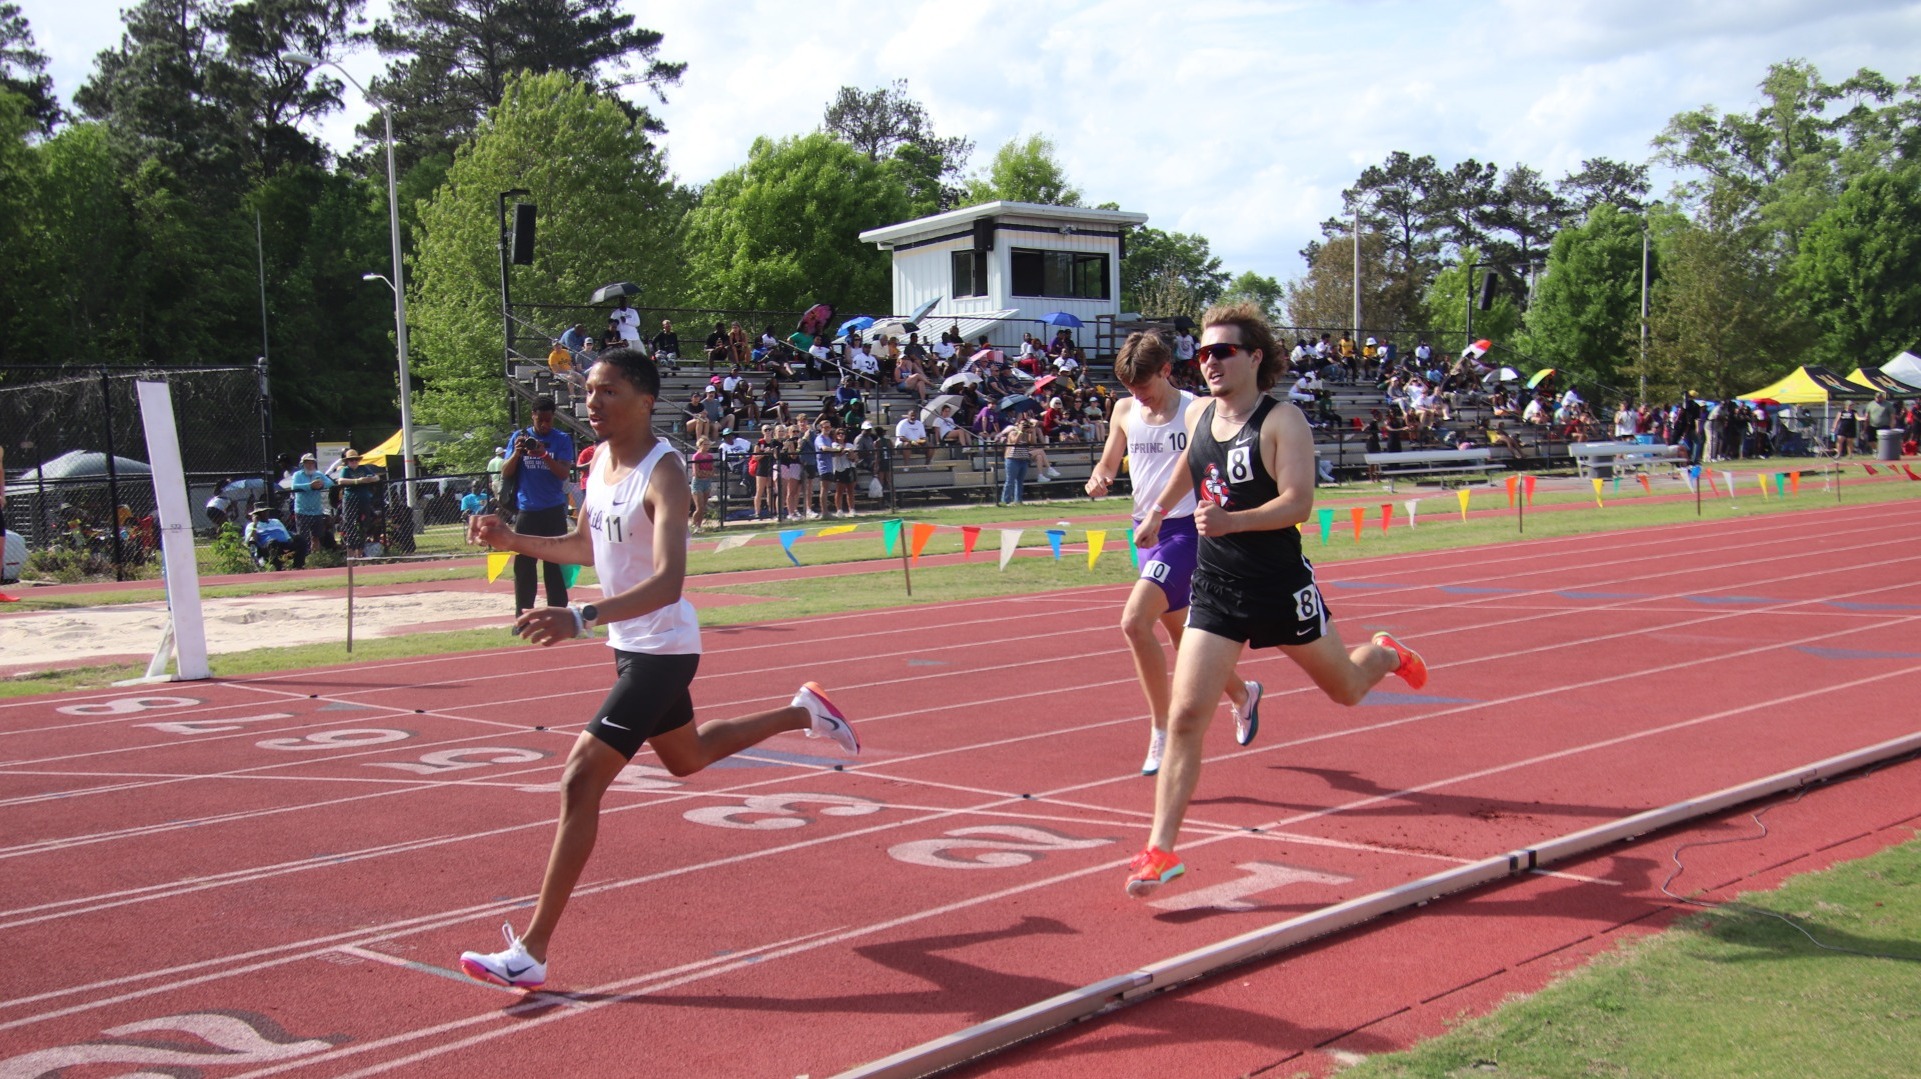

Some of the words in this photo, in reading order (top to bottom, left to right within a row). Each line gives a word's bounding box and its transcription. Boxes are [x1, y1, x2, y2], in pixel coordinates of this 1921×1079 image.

[1130, 442, 1164, 454] SPRING
[1169, 431, 1187, 451] 10
[1232, 449, 1247, 481] 8
[605, 515, 623, 543] 11
[1148, 562, 1165, 579] 10
[1300, 589, 1314, 618] 8
[56, 696, 201, 716] 8
[131, 713, 295, 735] 7
[255, 728, 410, 750] 6
[361, 747, 544, 775] 5
[682, 793, 881, 830] 3
[888, 824, 1114, 869] 2
[1146, 861, 1355, 912] 1
